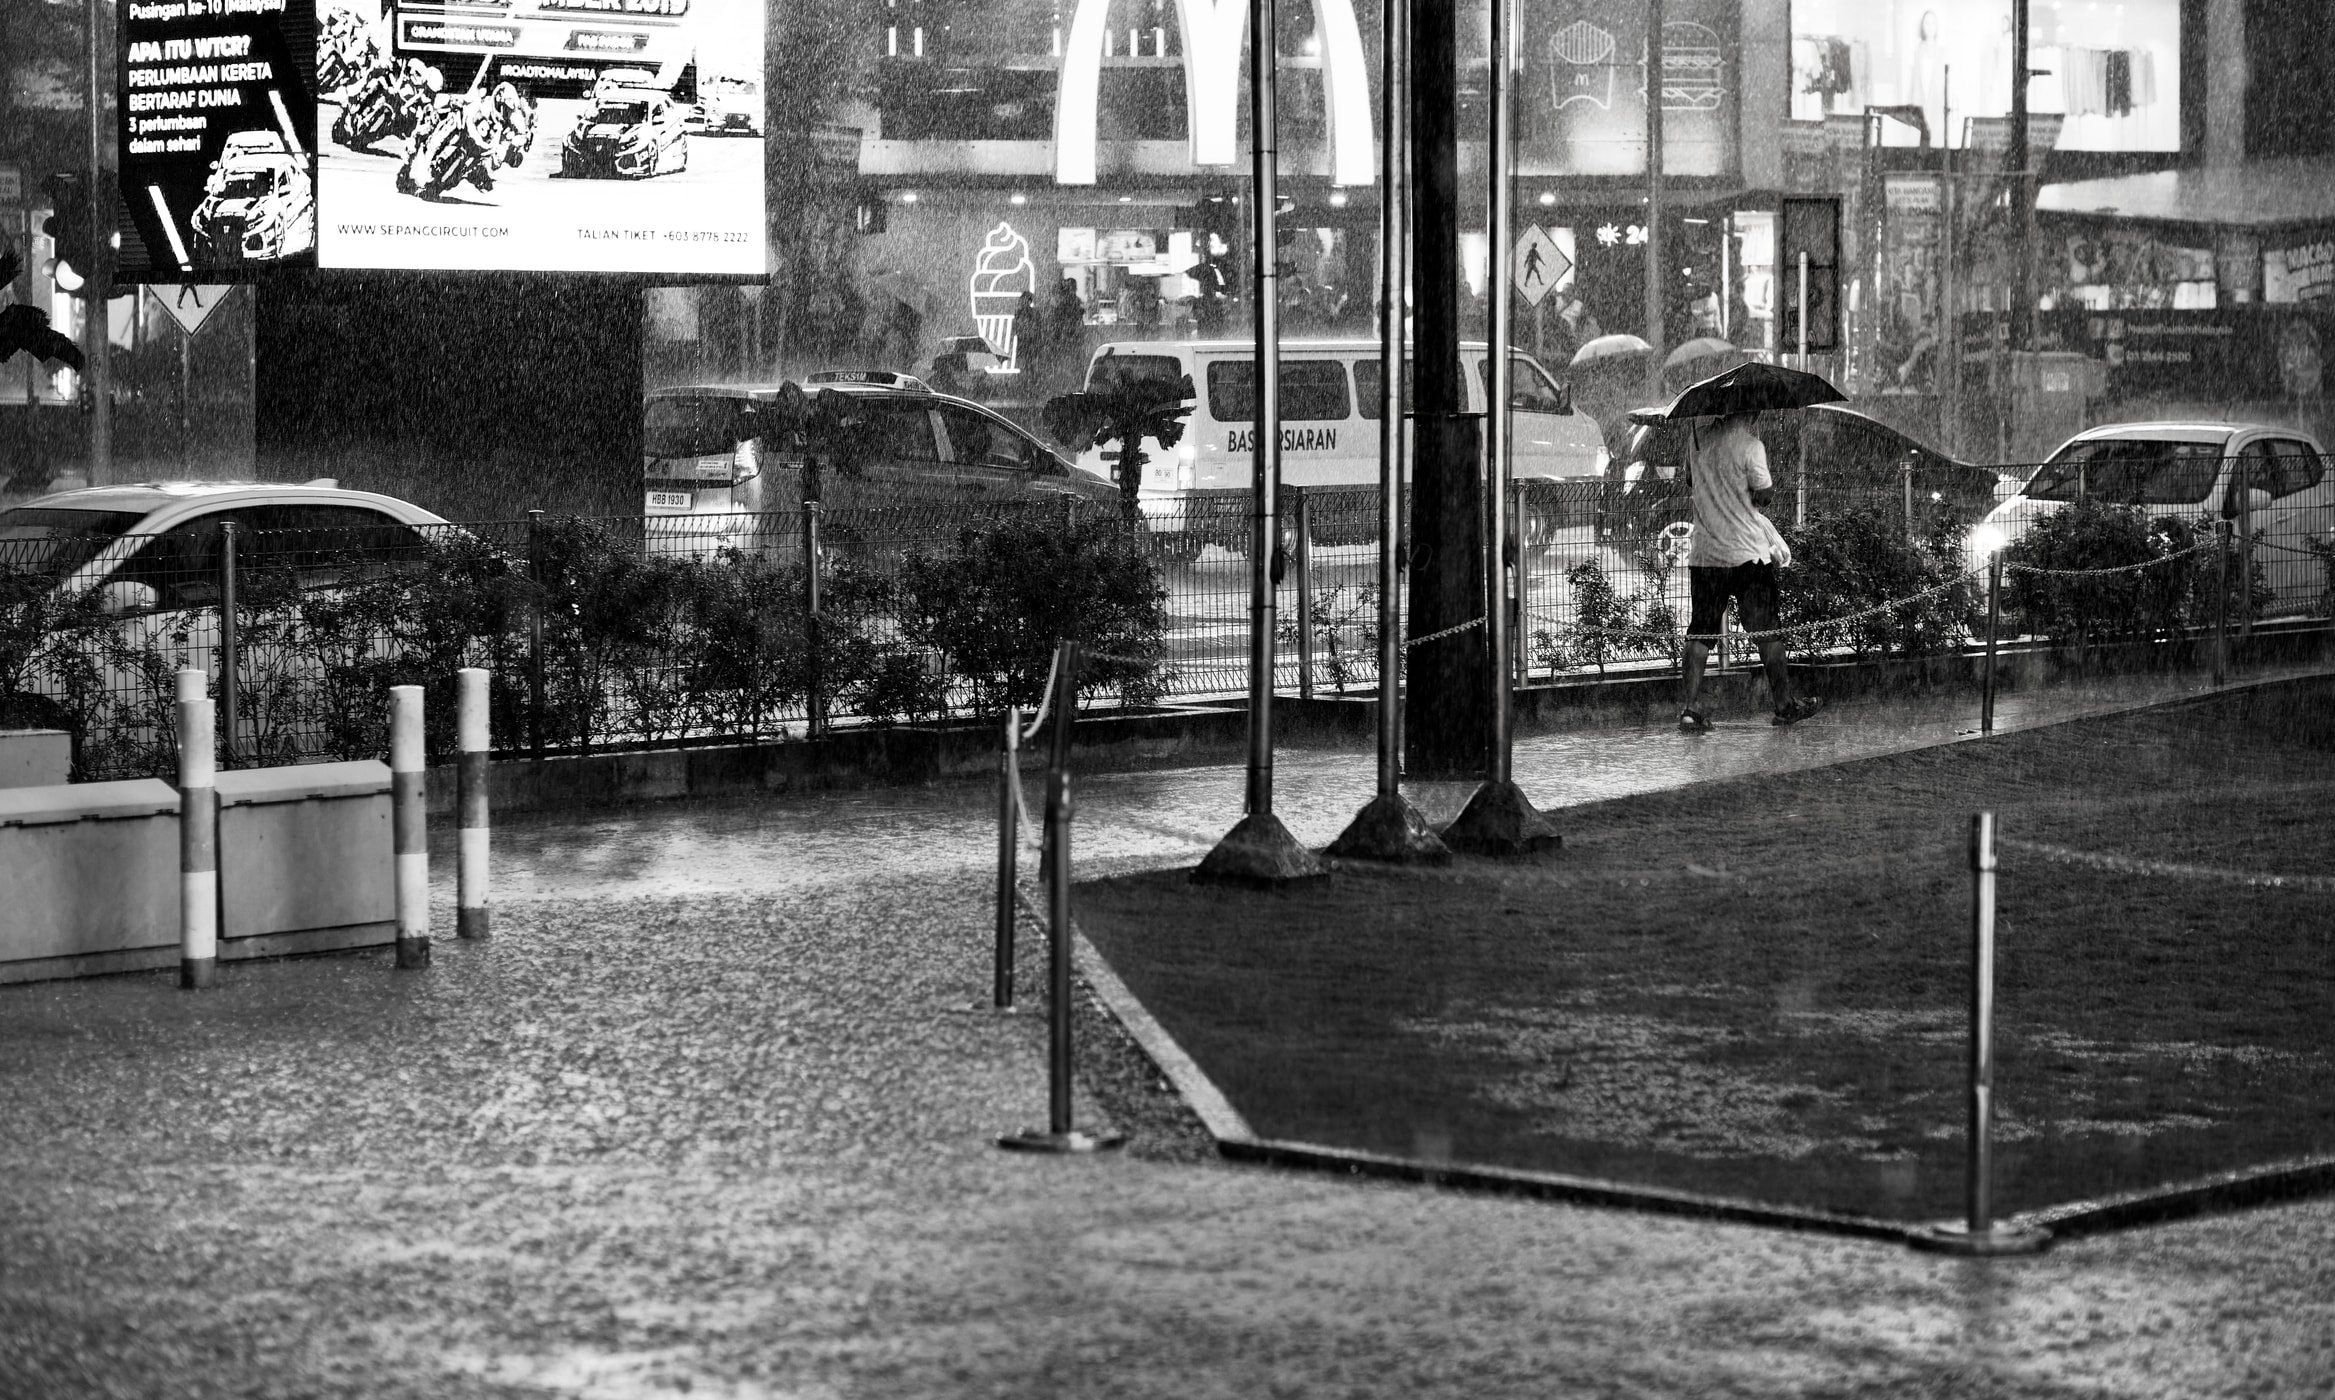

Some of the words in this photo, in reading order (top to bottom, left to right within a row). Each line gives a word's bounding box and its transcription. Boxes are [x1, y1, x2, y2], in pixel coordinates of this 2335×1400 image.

[129, 3, 186, 21] Pusingan
[187, 0, 223, 16] ke-10
[128, 42, 163, 62] APA
[164, 39, 192, 60] ITU
[194, 35, 251, 59] WTCR?
[129, 65, 218, 87] PERLUMBAAN
[220, 62, 273, 82] KERETA
[129, 91, 197, 111] BERTARAF
[198, 88, 242, 107] DUNIA
[129, 117, 137, 132] 3
[139, 114, 207, 135] perlumbaan
[129, 138, 165, 153] dalam
[166, 135, 201, 152] sehari
[337, 224, 509, 238] WWWSEPANGCIRCUITCOM
[577, 229, 619, 240] TALIAN
[624, 230, 656, 241] TIKET
[692, 231, 720, 242] 8778
[723, 232, 750, 243] 2222
[1228, 430, 1255, 452] BAS
[1279, 428, 1337, 451] RSIARAN
[668, 494, 684, 505] 1930
